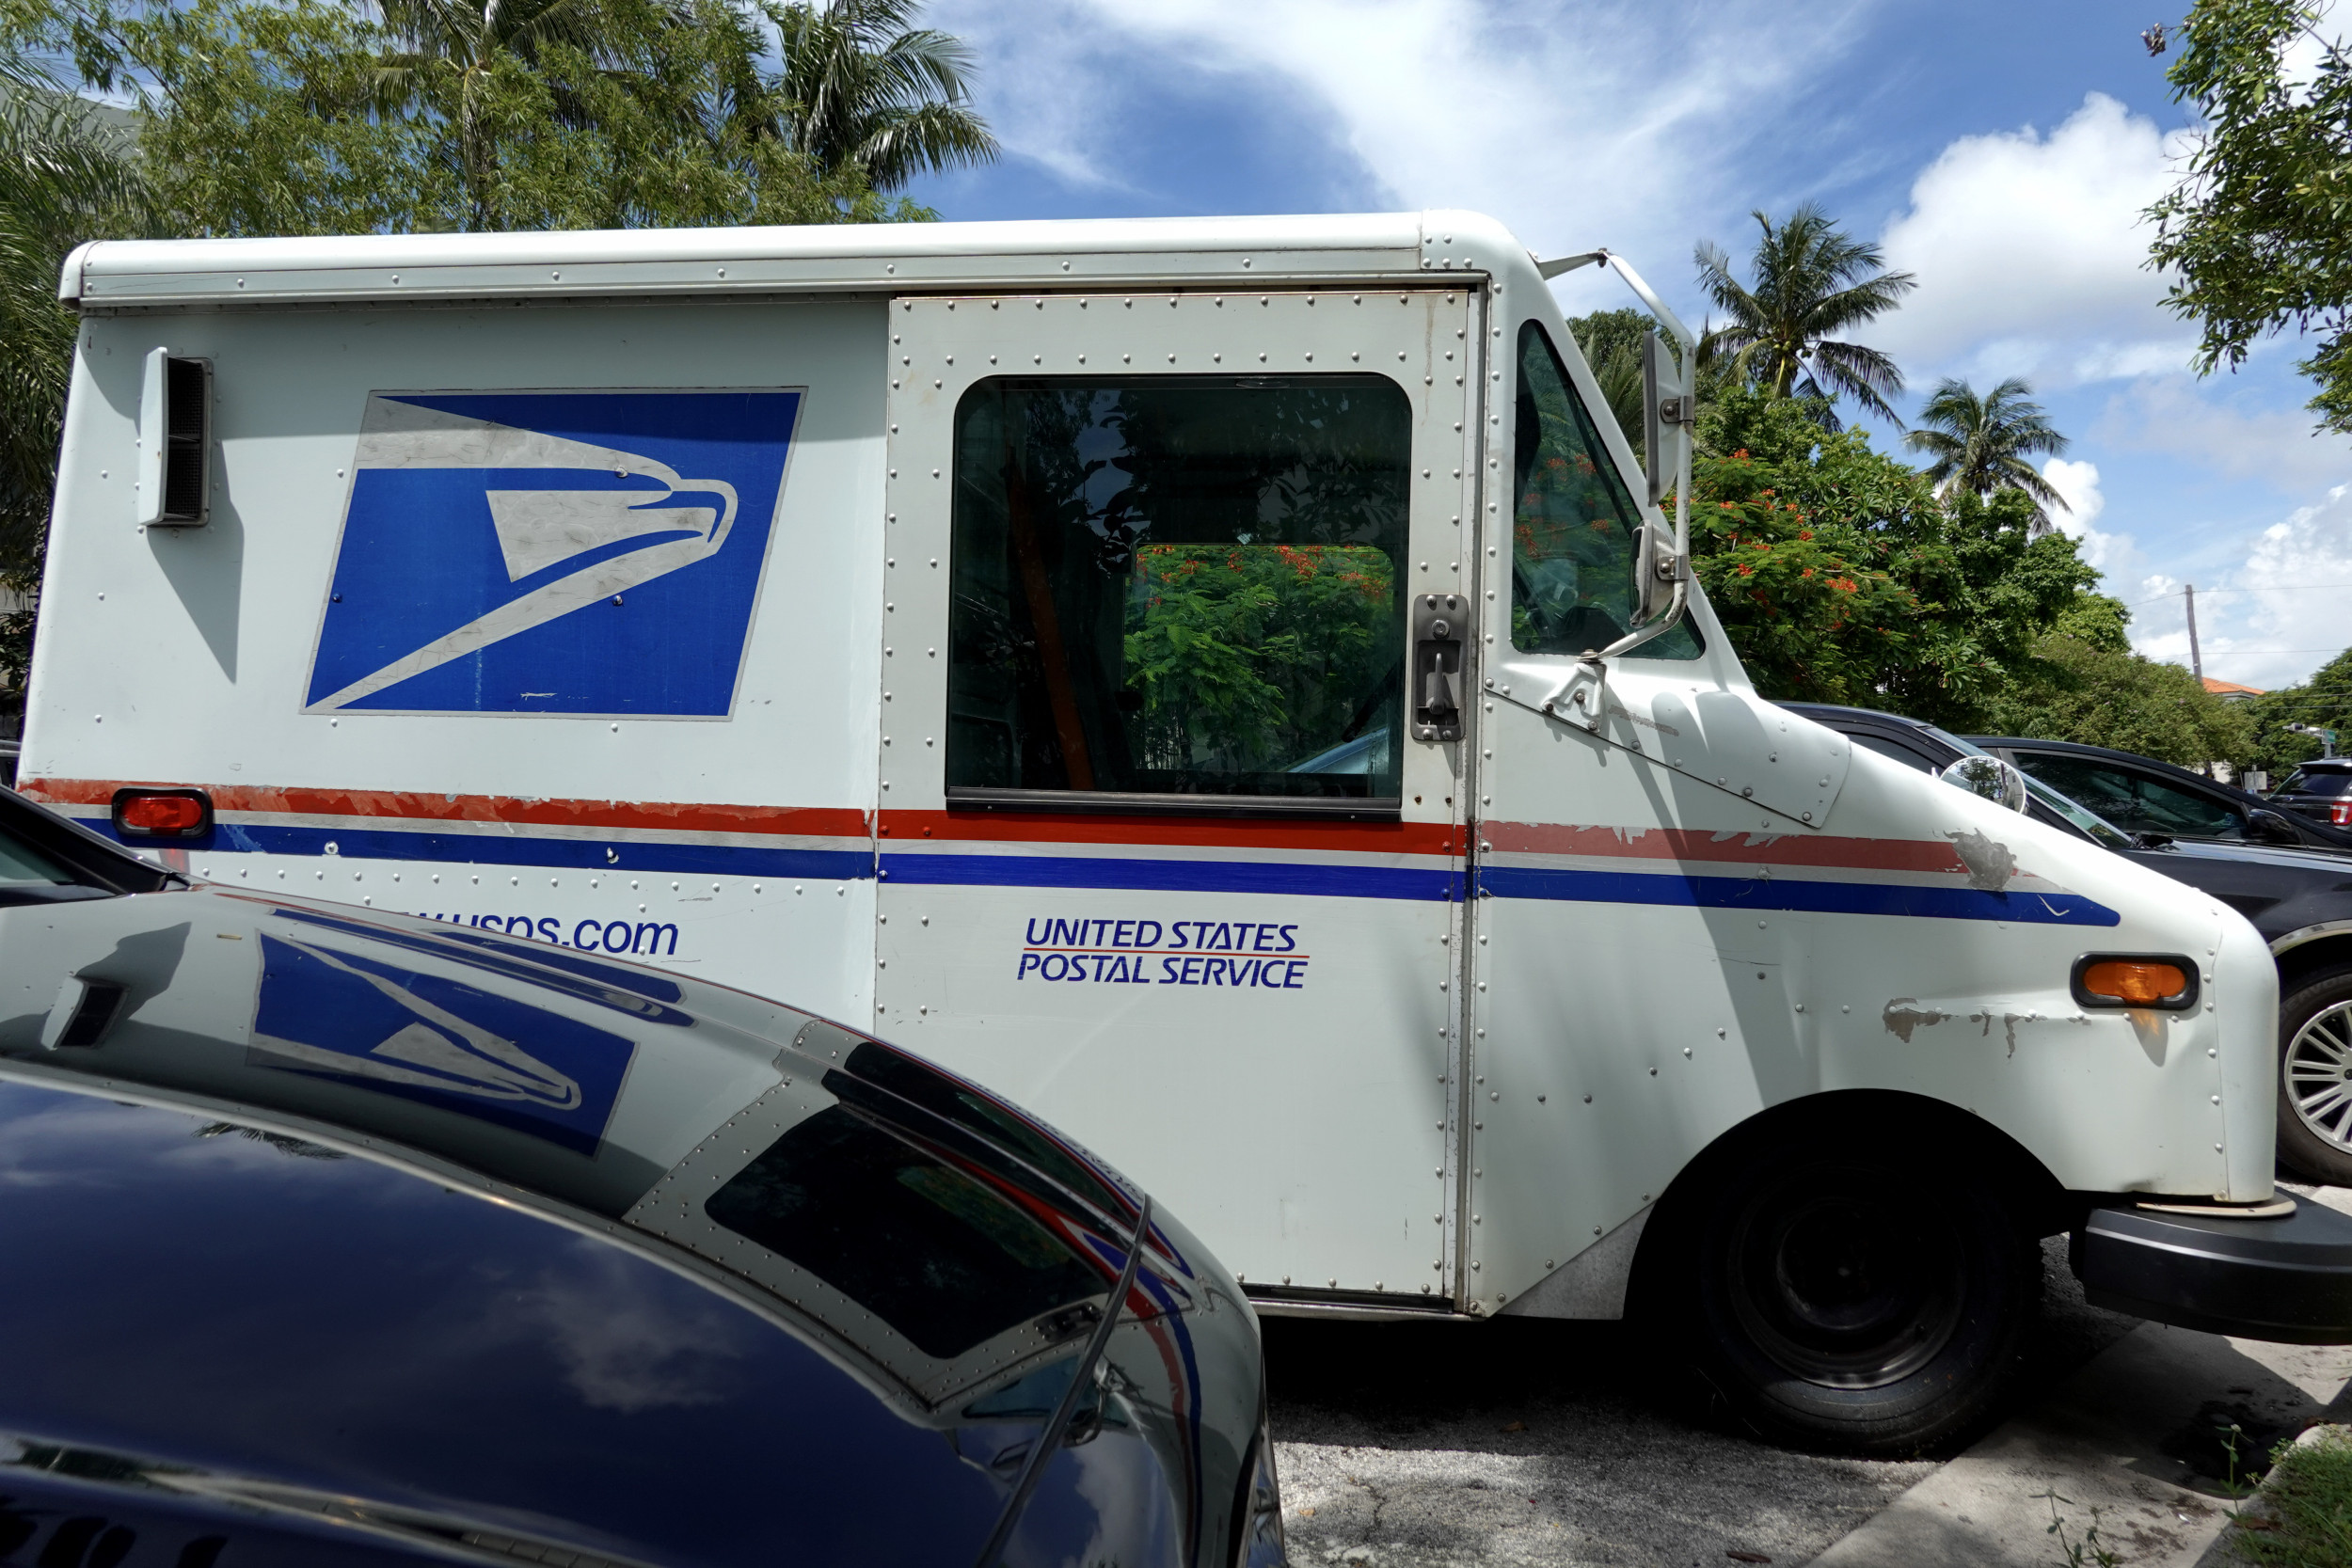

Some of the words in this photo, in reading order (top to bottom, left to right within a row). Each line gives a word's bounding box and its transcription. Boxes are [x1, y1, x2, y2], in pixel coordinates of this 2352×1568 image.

[1025, 917, 1163, 948] UNITED
[1168, 921, 1298, 952] STATES
[1017, 953, 1151, 984] POSTAL
[1158, 957, 1309, 989] SERVICE
